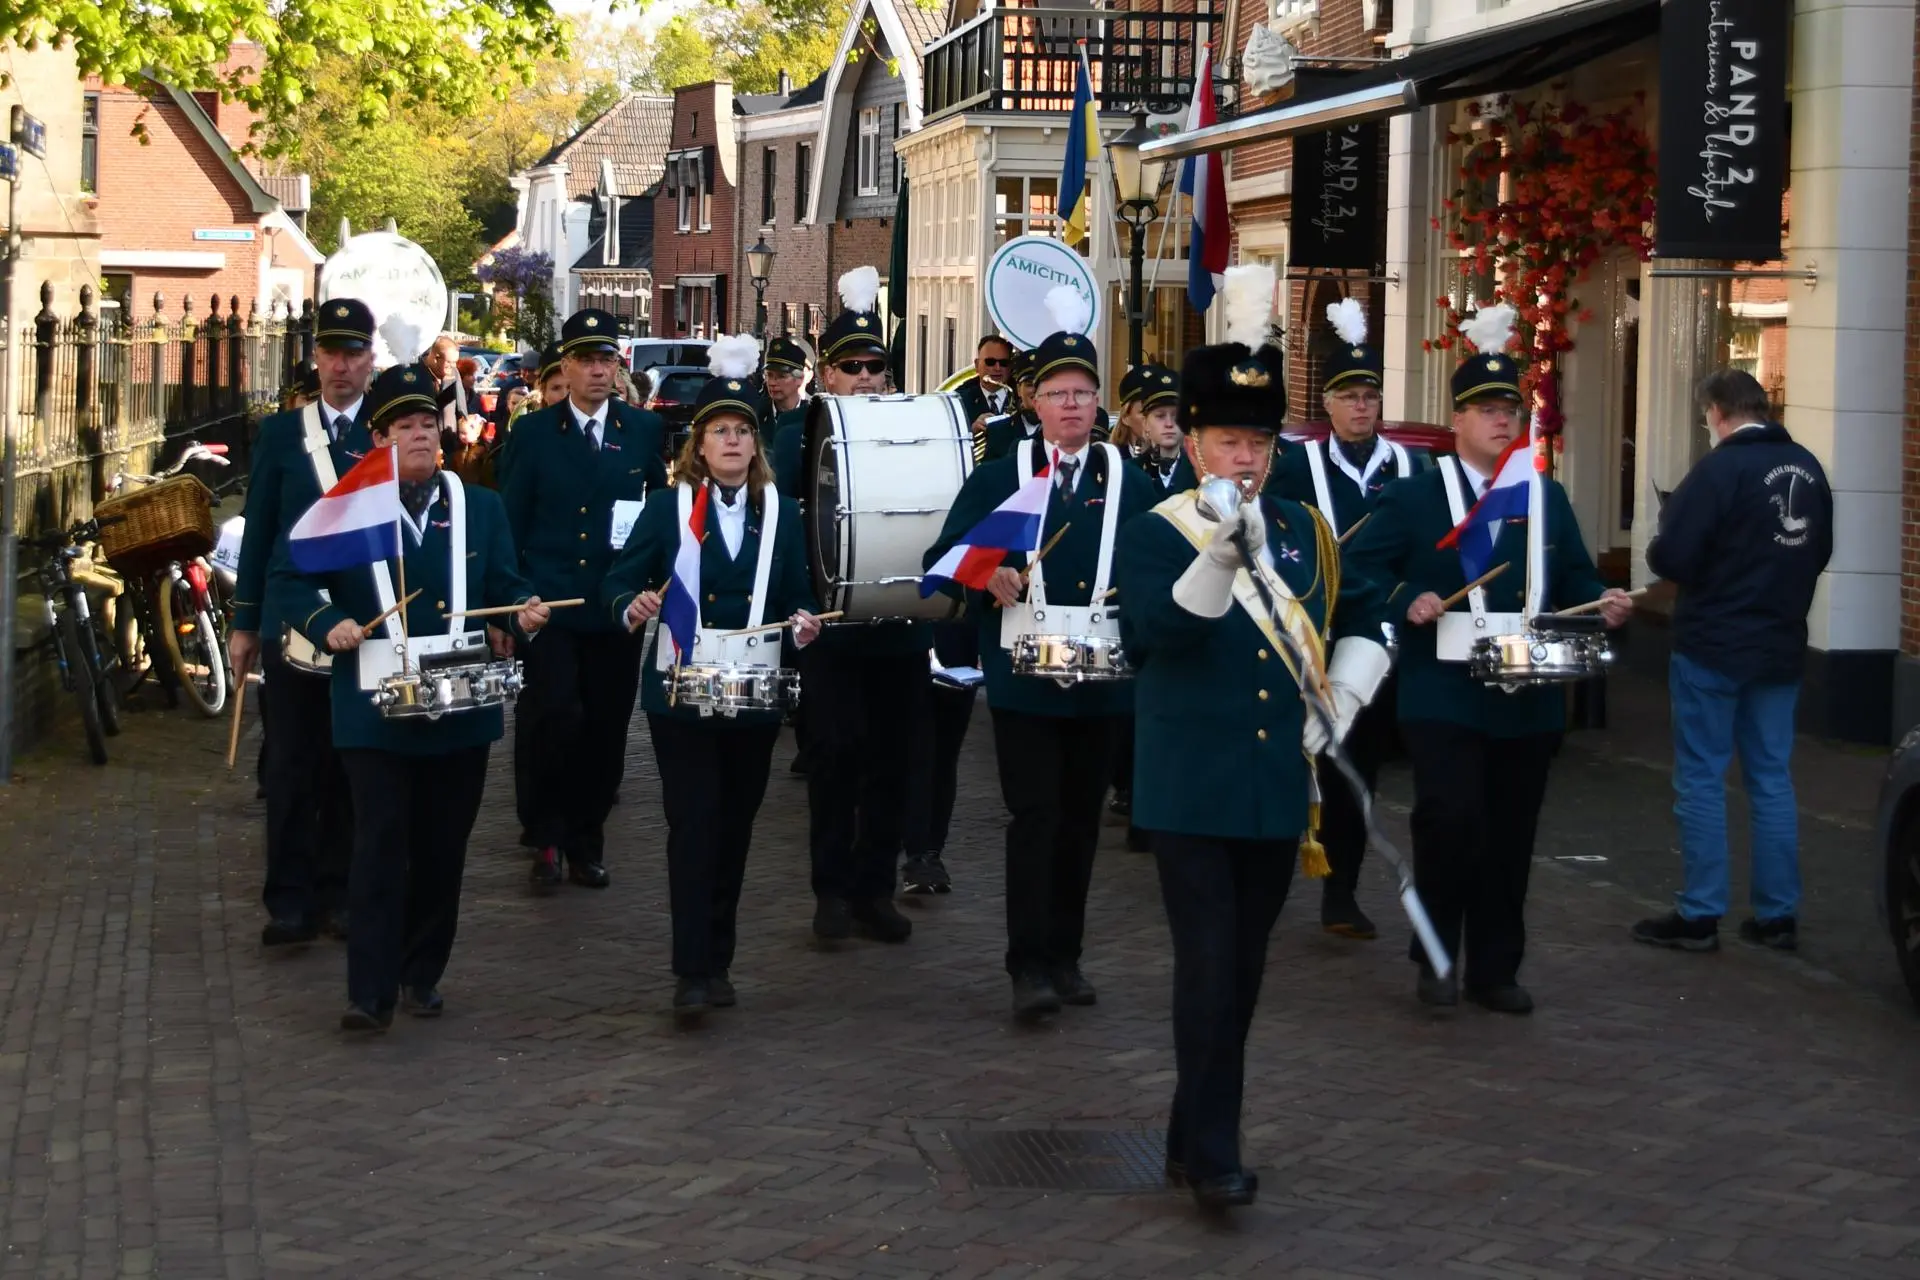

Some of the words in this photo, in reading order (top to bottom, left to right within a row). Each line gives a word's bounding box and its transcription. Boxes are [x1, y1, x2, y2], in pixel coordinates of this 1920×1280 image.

[1706, 1, 1735, 95] interieur
[1729, 41, 1757, 146] PAND
[1704, 101, 1730, 125] &
[1687, 134, 1736, 223] lifestyle
[1728, 167, 1754, 184] 2
[1338, 206, 1357, 217] 2
[1006, 256, 1081, 290] AMICITIA
